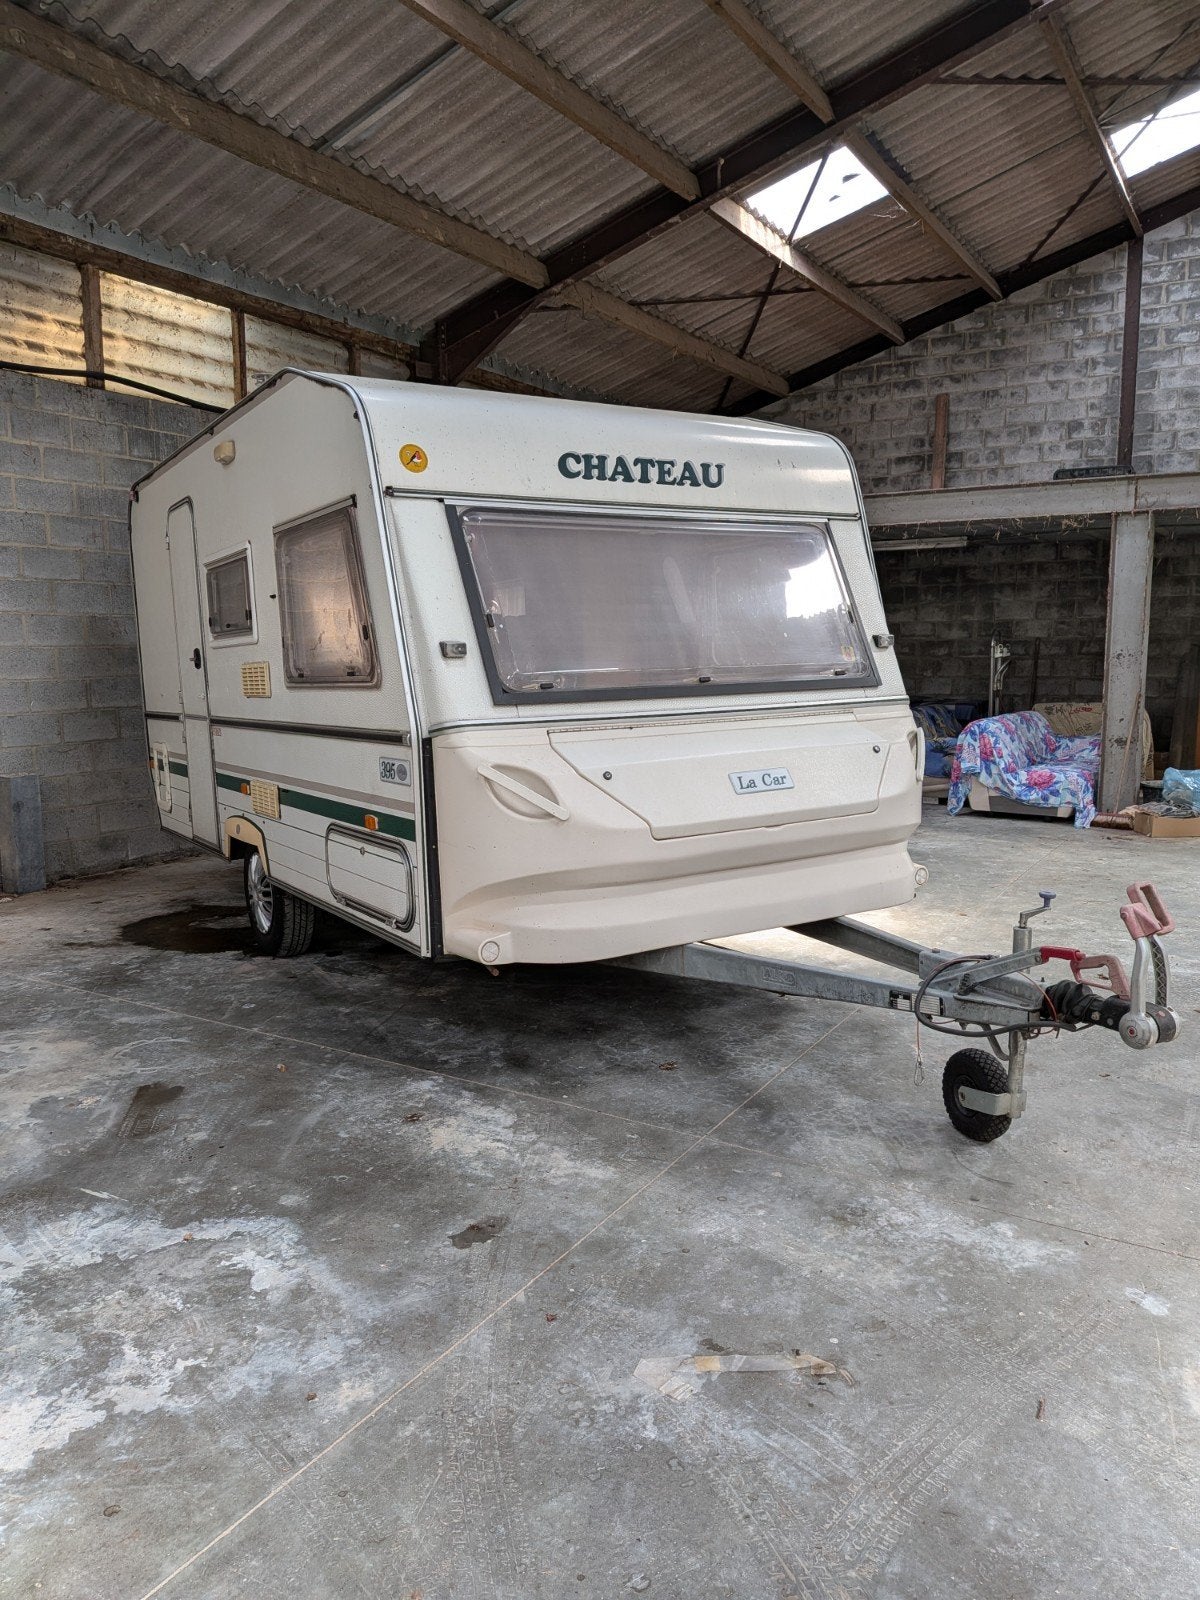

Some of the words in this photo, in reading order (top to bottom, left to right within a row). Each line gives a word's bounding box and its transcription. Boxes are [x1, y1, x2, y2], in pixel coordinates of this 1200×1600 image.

[557, 451, 726, 488] CHATEAU
[381, 761, 396, 780] 395
[737, 776, 757, 789] La
[762, 773, 787, 787] Car
